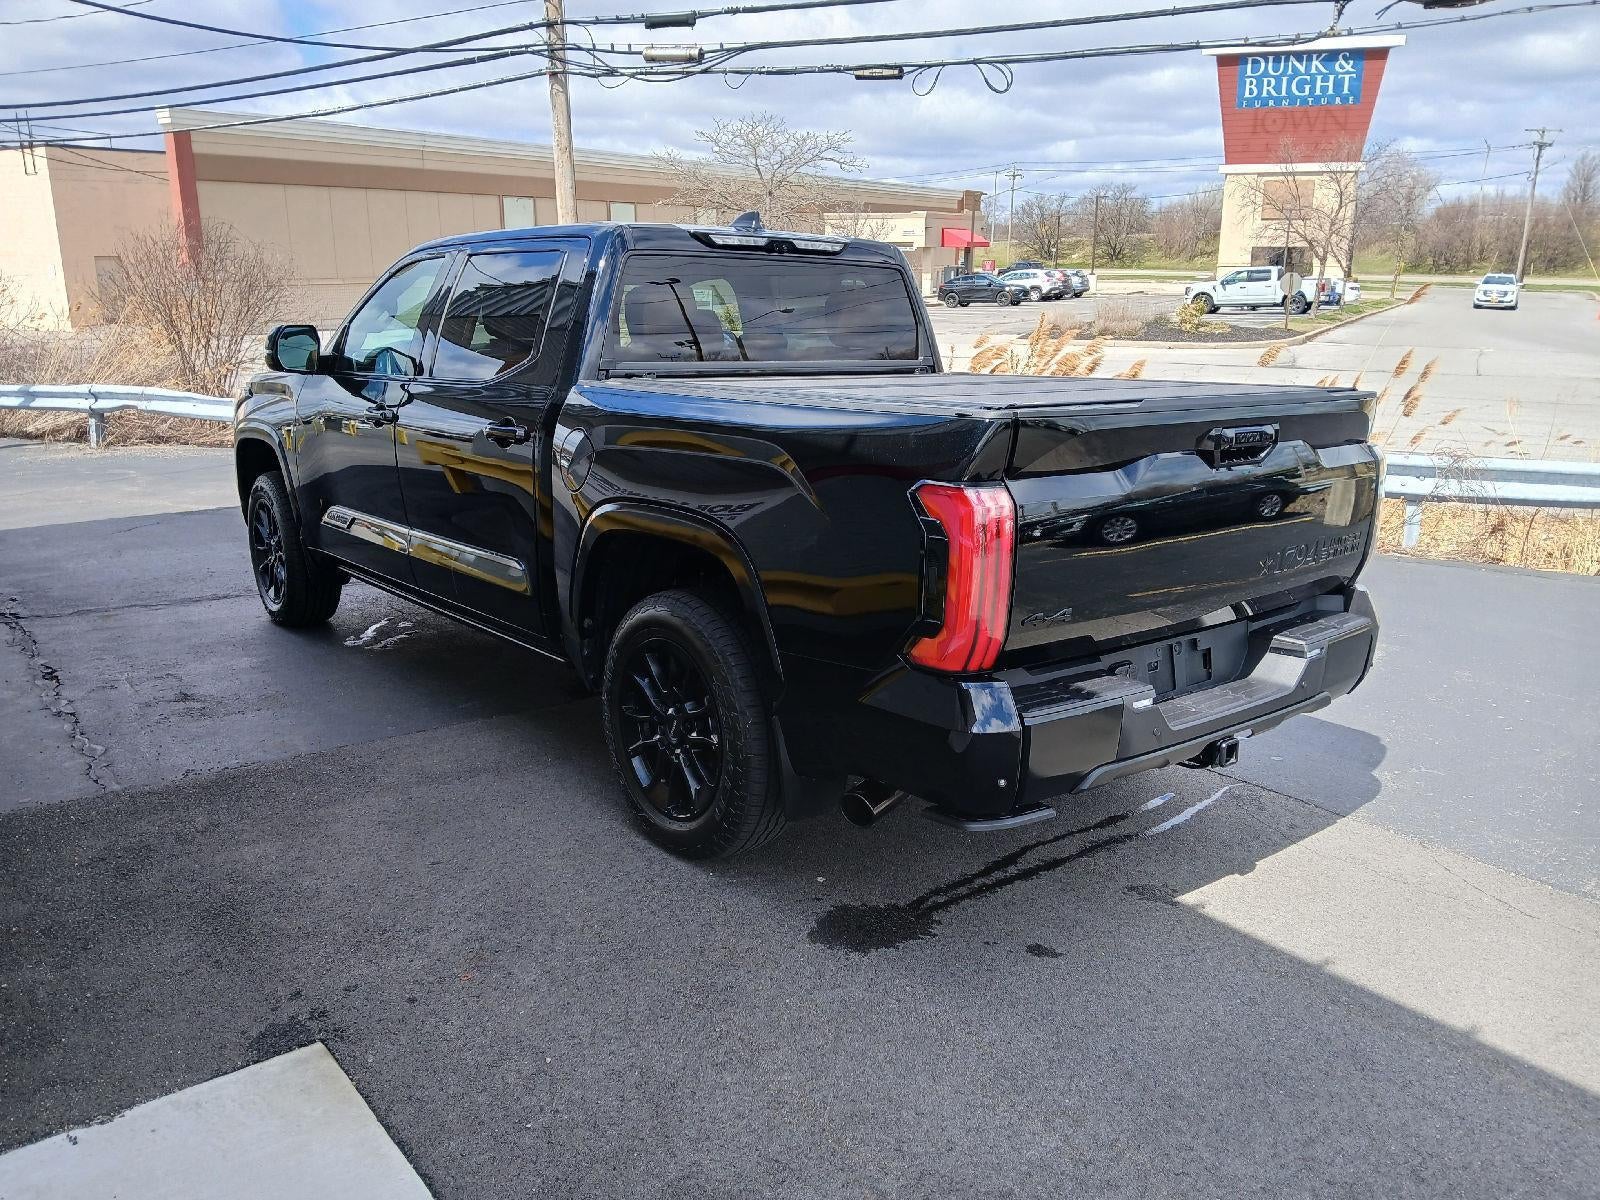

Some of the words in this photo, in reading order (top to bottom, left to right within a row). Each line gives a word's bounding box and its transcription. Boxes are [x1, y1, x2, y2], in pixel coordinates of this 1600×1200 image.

[1245, 53, 1329, 77] DUNK
[1334, 51, 1357, 73] &
[1243, 73, 1357, 98] BRIGHT
[1242, 96, 1355, 108] FURNITURE
